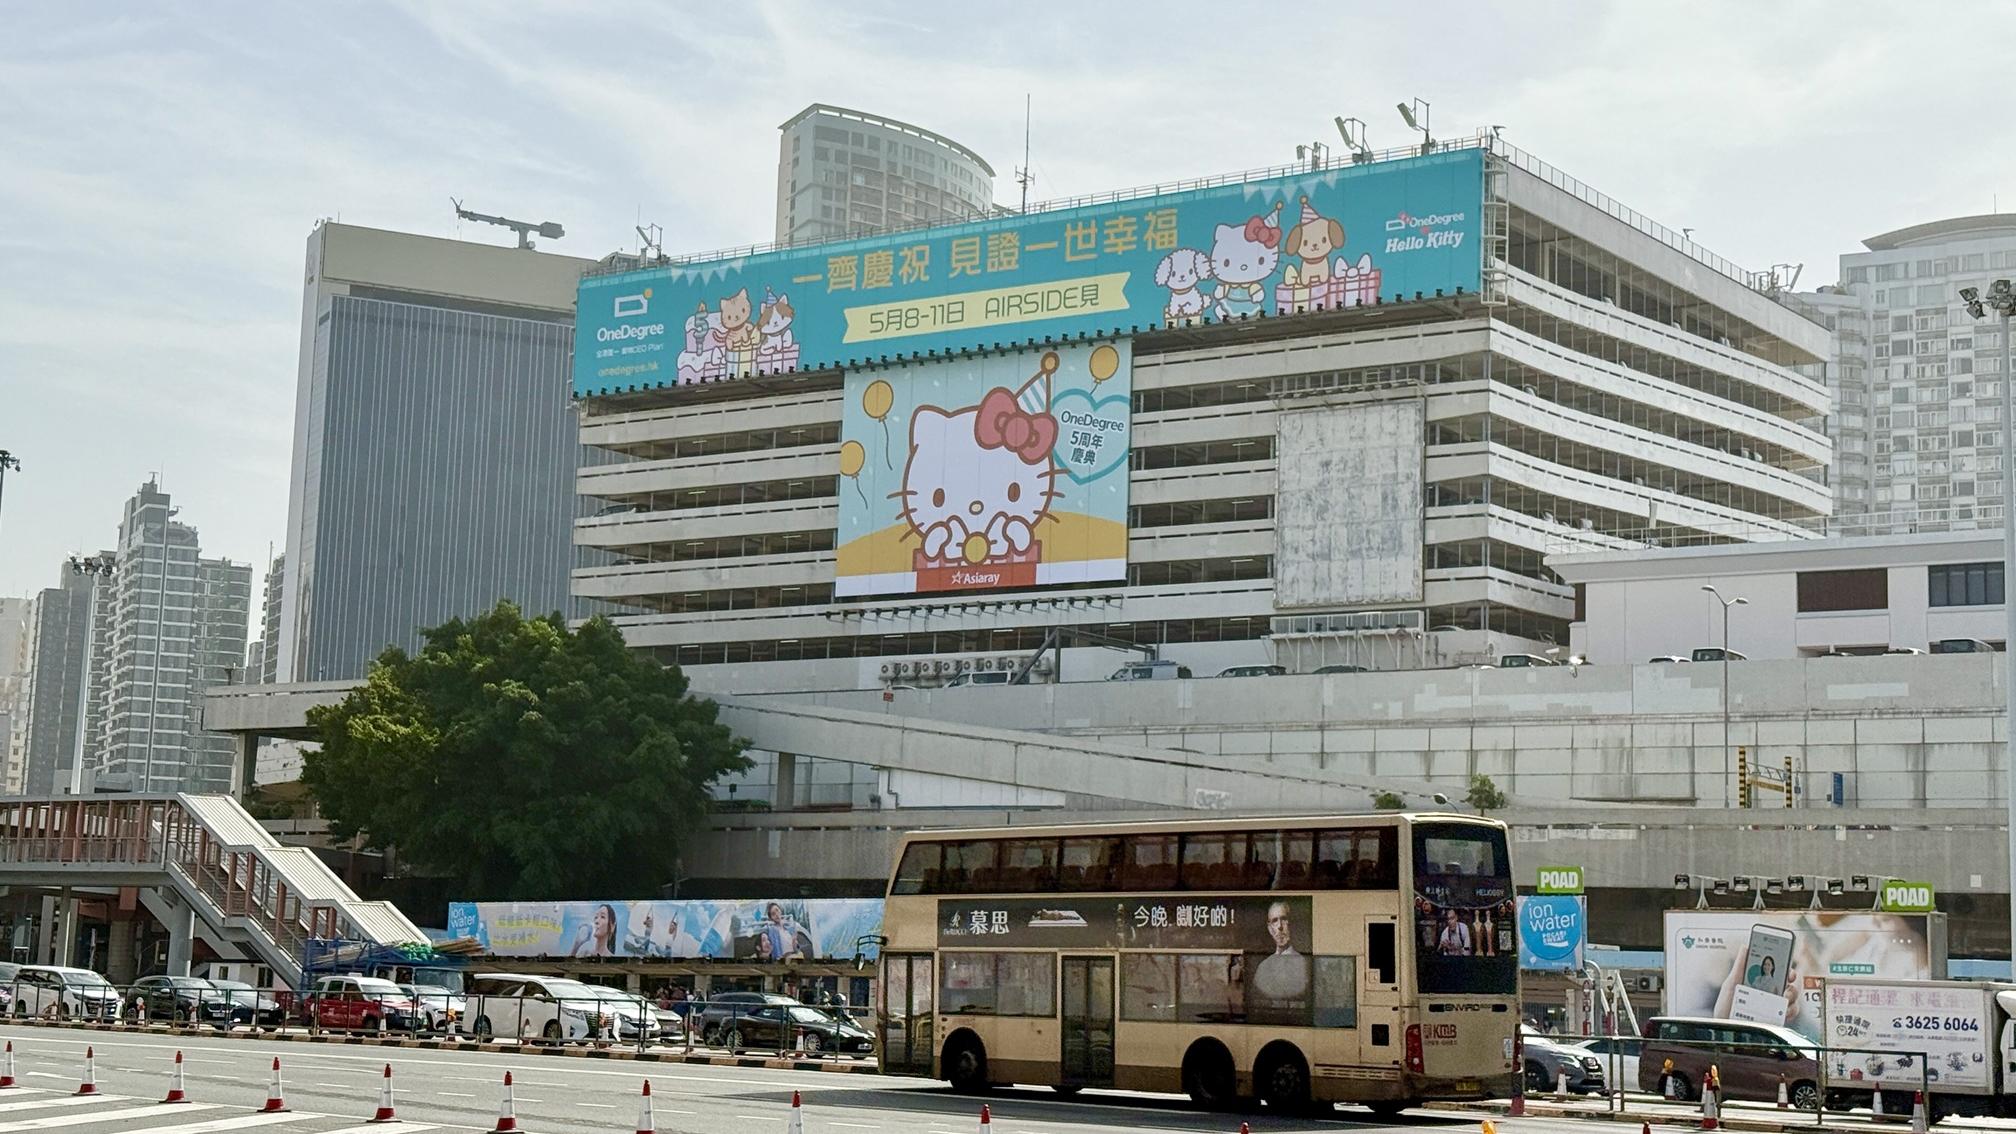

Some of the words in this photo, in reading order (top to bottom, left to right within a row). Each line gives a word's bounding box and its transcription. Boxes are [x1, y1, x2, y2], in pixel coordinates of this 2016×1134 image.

[1410, 212, 1465, 228] OneDegree
[793, 244, 930, 294] 一齊慶祝
[949, 208, 1179, 279] 見證一世幸福
[1385, 236, 1424, 254] Hello
[1426, 230, 1465, 249] Kitty
[869, 300, 965, 333] 5月8-11日
[984, 284, 1100, 319] AIRSIDE見
[596, 323, 665, 342] OneDegree
[1061, 410, 1125, 433] OneDegree
[1070, 431, 1104, 450] 5周年
[1070, 450, 1096, 466] 慶典
[963, 572, 1001, 586] Asiaray
[1541, 871, 1578, 889] POAD
[1887, 887, 1930, 906] POAD
[1528, 903, 1553, 919] ion
[969, 910, 1010, 935] 慕思
[1530, 913, 1577, 932] water
[1905, 1015, 1940, 1030] 3625
[1943, 1016, 1979, 1031] 6064
